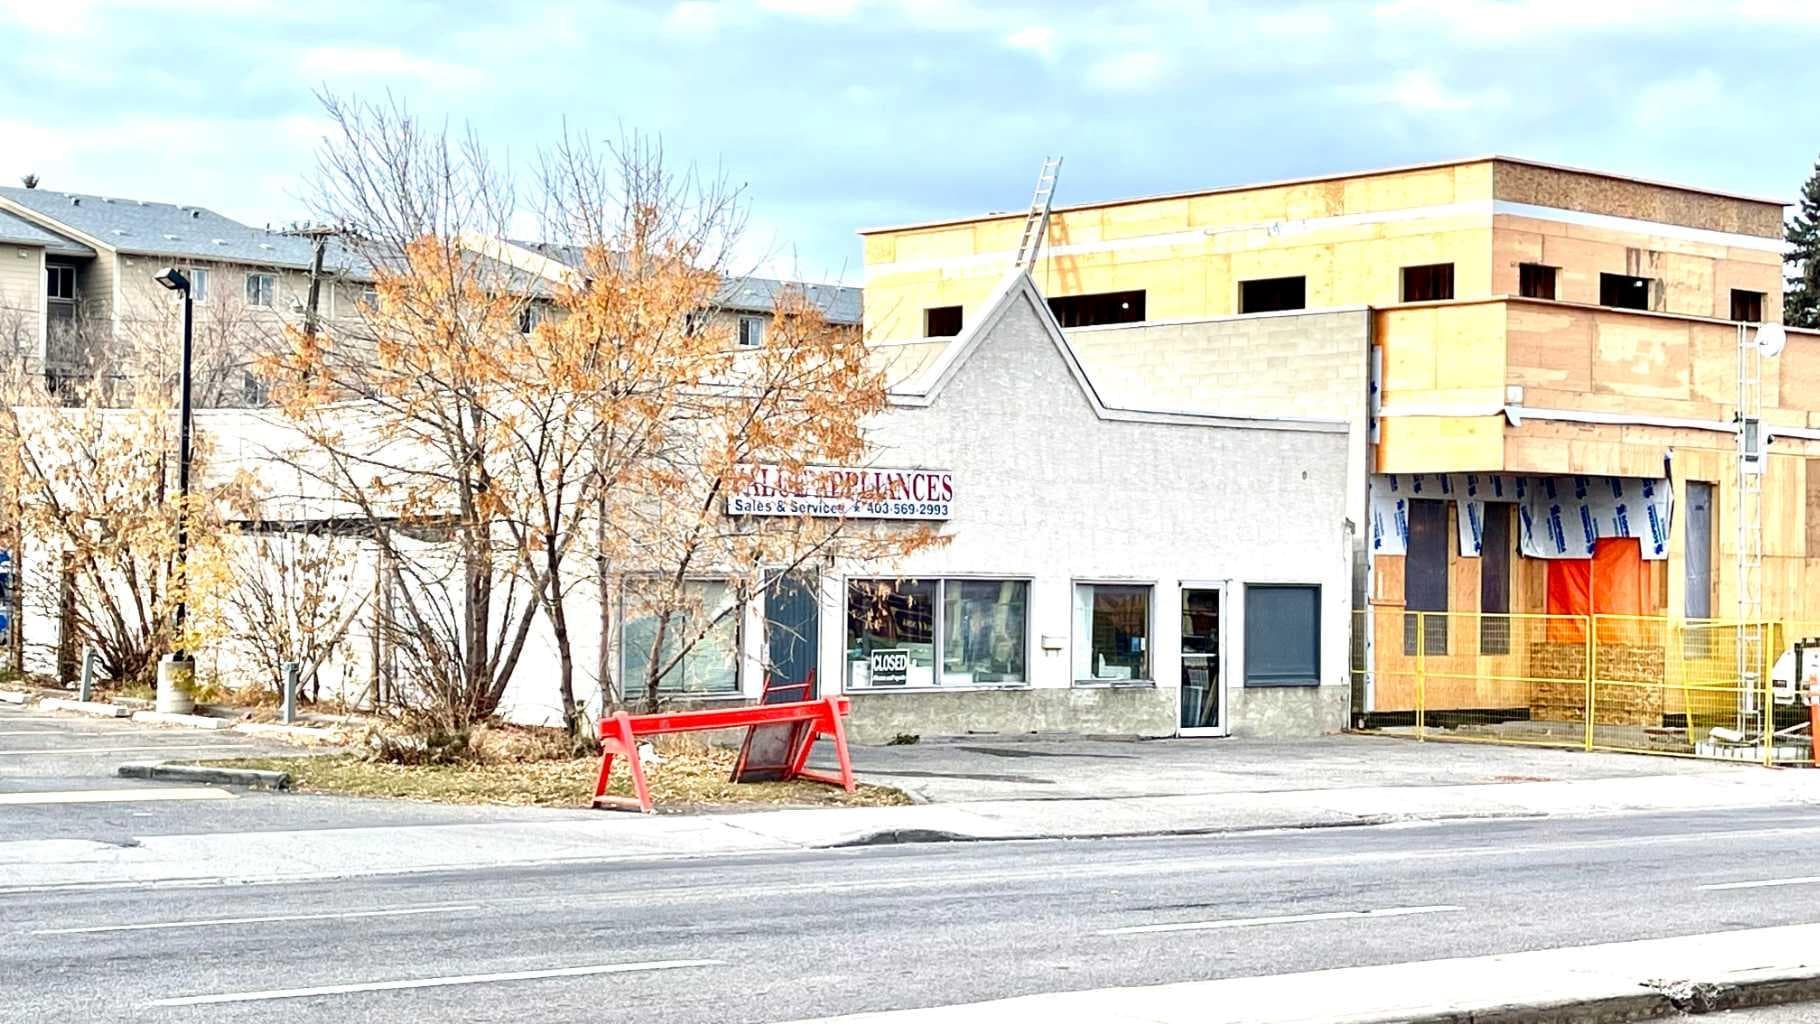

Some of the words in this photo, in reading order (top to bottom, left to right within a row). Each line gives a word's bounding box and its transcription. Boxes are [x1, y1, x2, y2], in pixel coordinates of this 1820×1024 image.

[731, 467, 811, 497] ALU
[735, 499, 772, 511] Sales
[776, 500, 786, 512] &
[791, 501, 844, 514] Service
[874, 655, 907, 671] CLOSED
